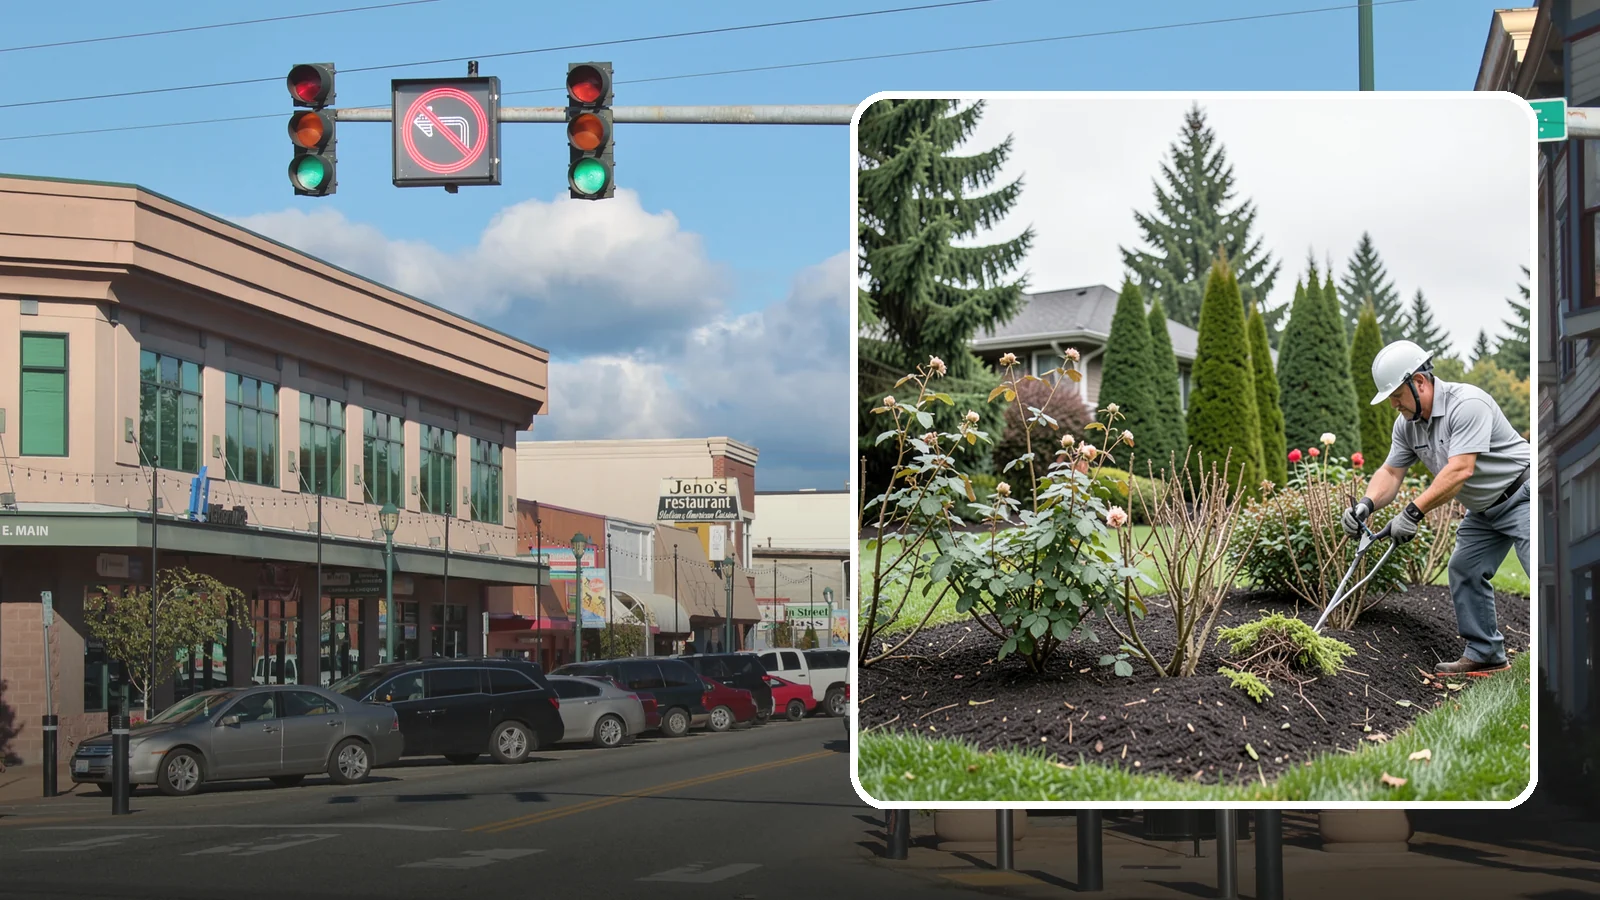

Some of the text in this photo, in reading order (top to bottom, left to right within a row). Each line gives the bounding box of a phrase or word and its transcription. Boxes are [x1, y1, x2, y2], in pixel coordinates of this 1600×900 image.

[670, 480, 727, 494] Jeno's
[665, 496, 731, 509] restaurant
[658, 510, 681, 519] Italian
[686, 509, 714, 519] American
[715, 509, 737, 519] Cuisine
[2, 525, 49, 536] E. MAIN
[797, 607, 828, 616] Street
